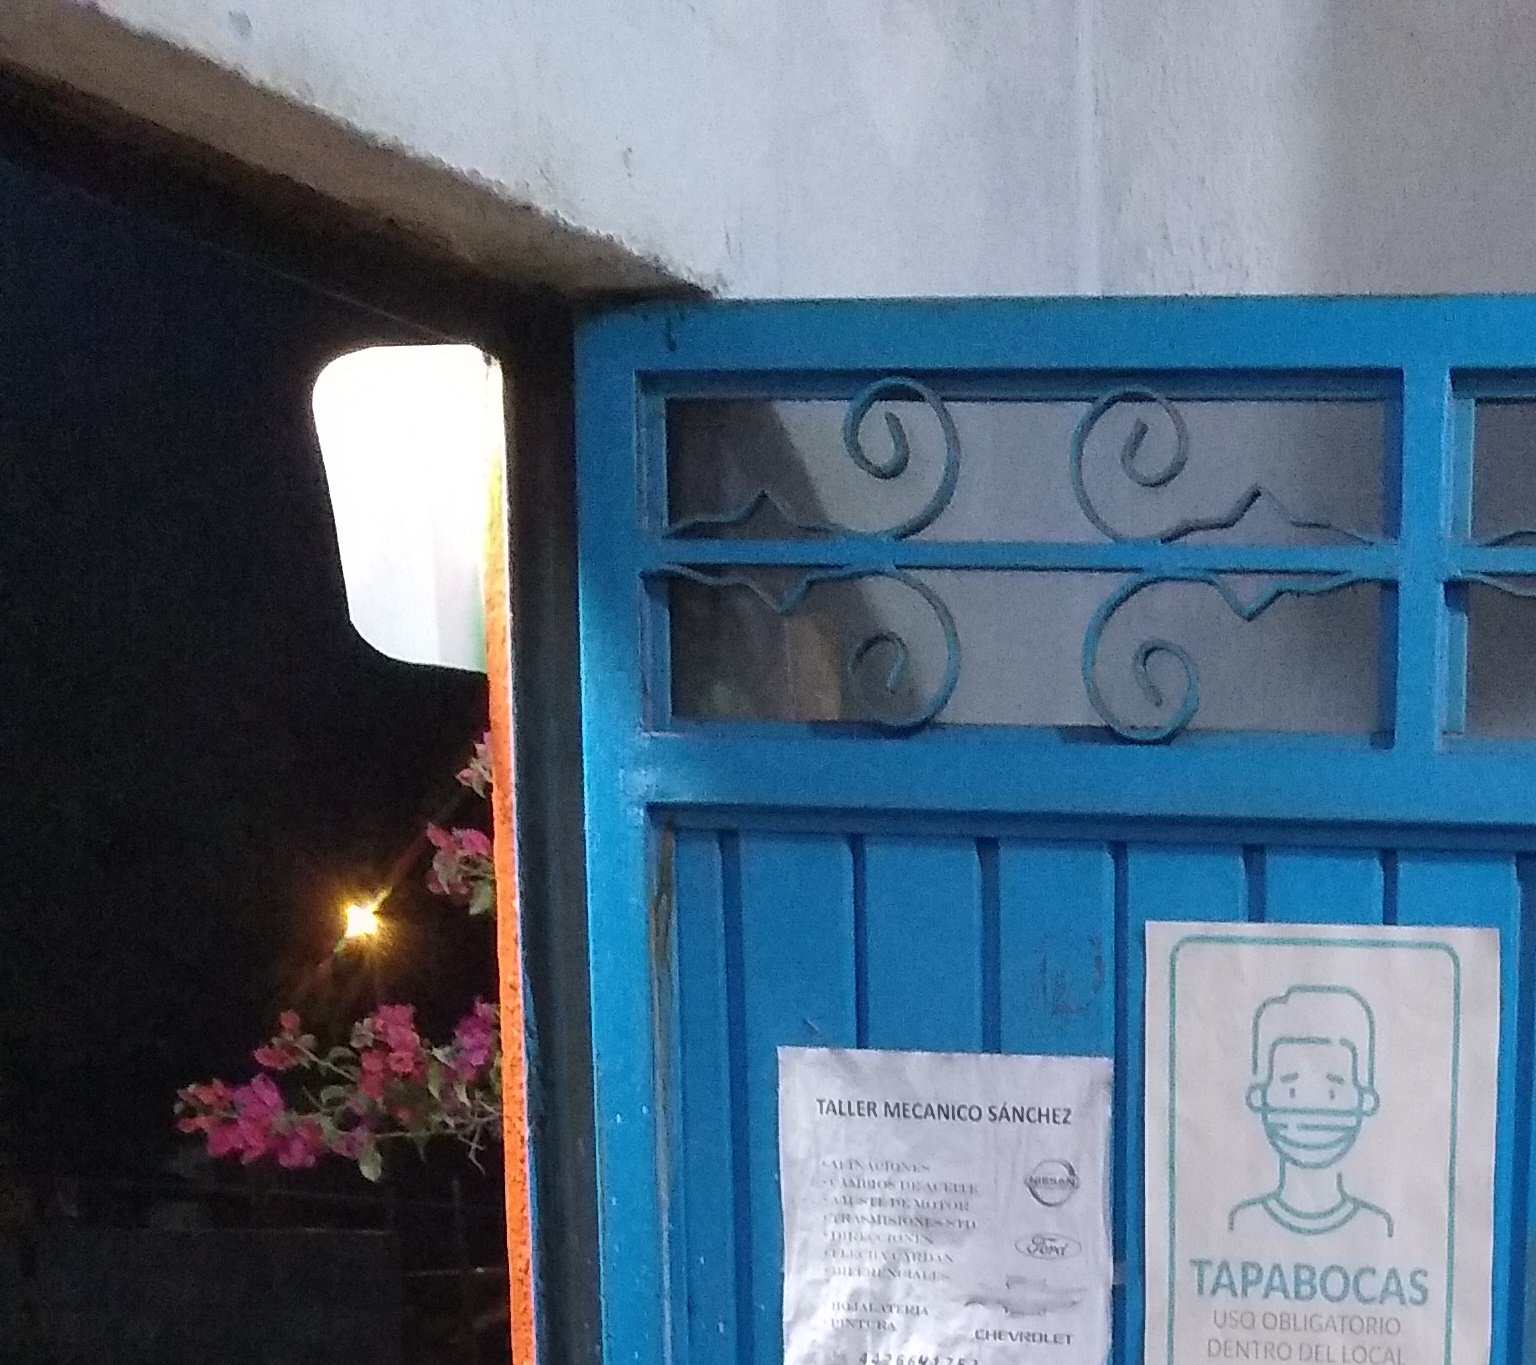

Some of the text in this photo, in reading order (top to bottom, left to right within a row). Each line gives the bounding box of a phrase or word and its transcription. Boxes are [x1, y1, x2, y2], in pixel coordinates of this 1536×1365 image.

[816, 1098, 1072, 1125] TALLER MECANICO SÁNCHEZ
[1190, 1258, 1431, 1307] TAPABOCAS
[1212, 1309, 1402, 1337] USO OBLIGATORIO
[974, 1329, 1072, 1346] CHEVROLET
[1206, 1339, 1293, 1362] DENTRO
[1297, 1343, 1338, 1365] DEL
